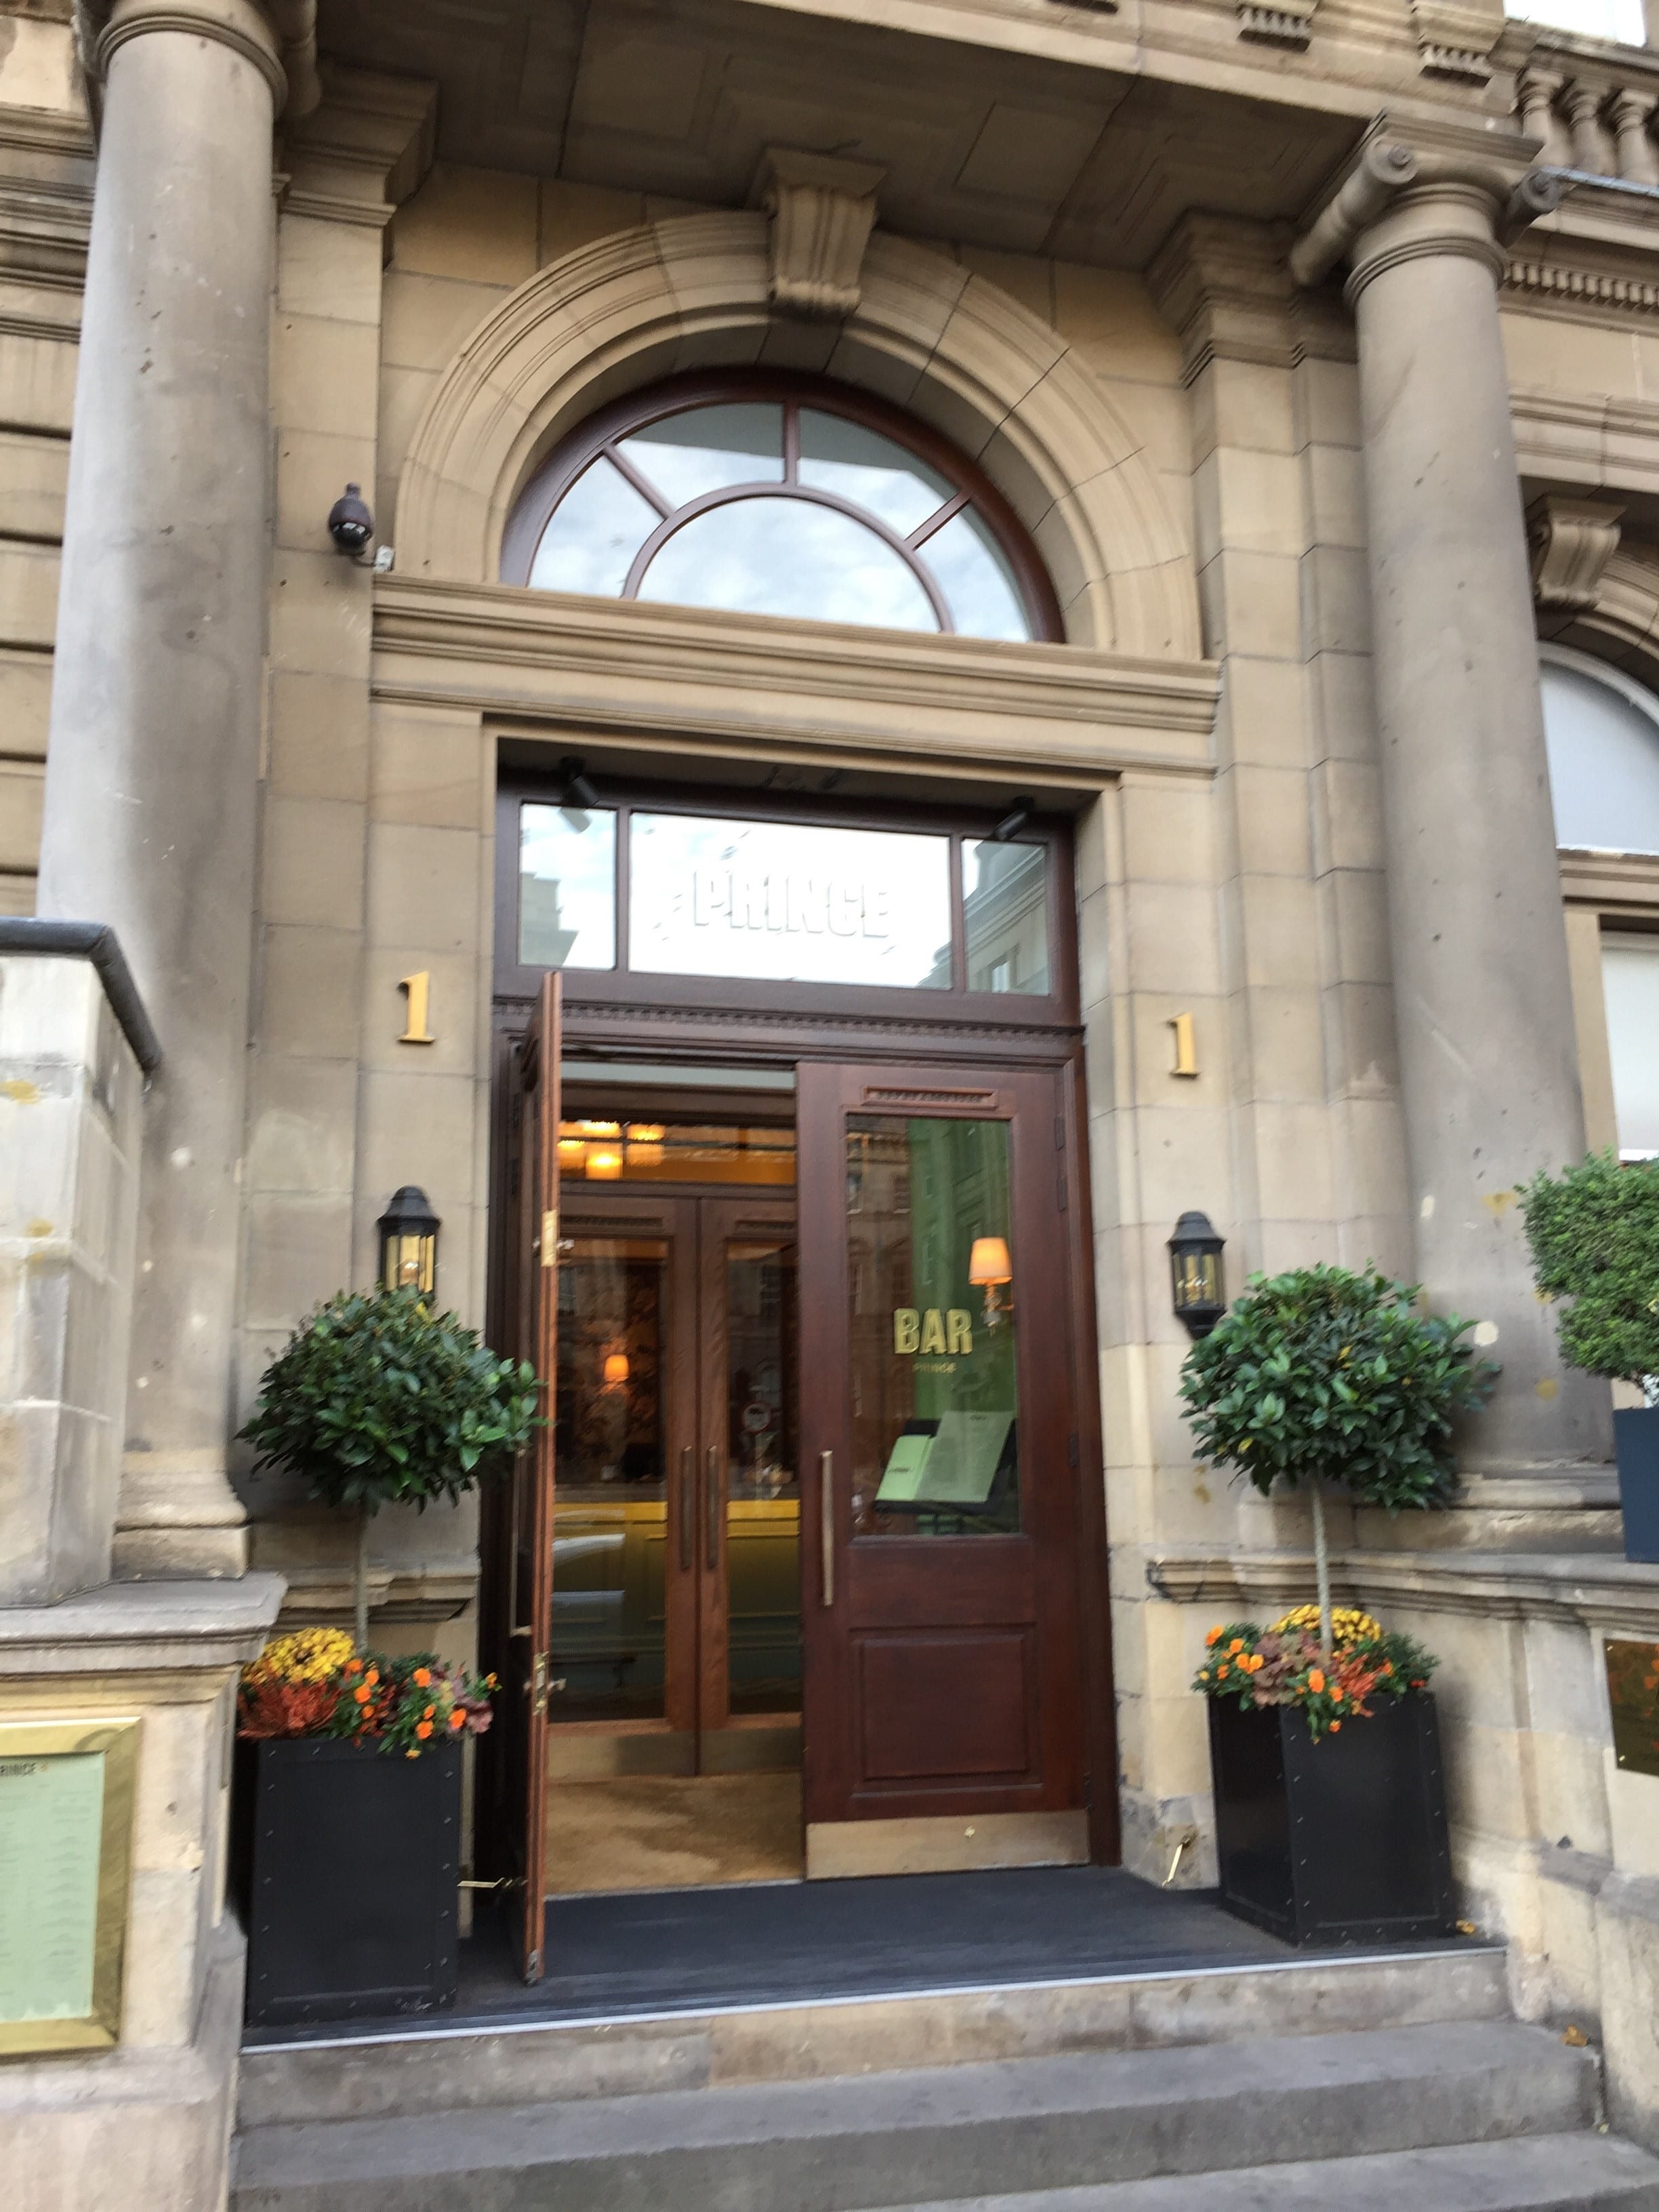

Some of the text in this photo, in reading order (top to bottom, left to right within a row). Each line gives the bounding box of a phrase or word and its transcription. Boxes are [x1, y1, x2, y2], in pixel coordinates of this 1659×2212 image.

[693, 866, 890, 938] PRINCE
[398, 970, 436, 1045] 1
[1167, 1011, 1200, 1080] 1
[893, 1307, 973, 1355] BAR
